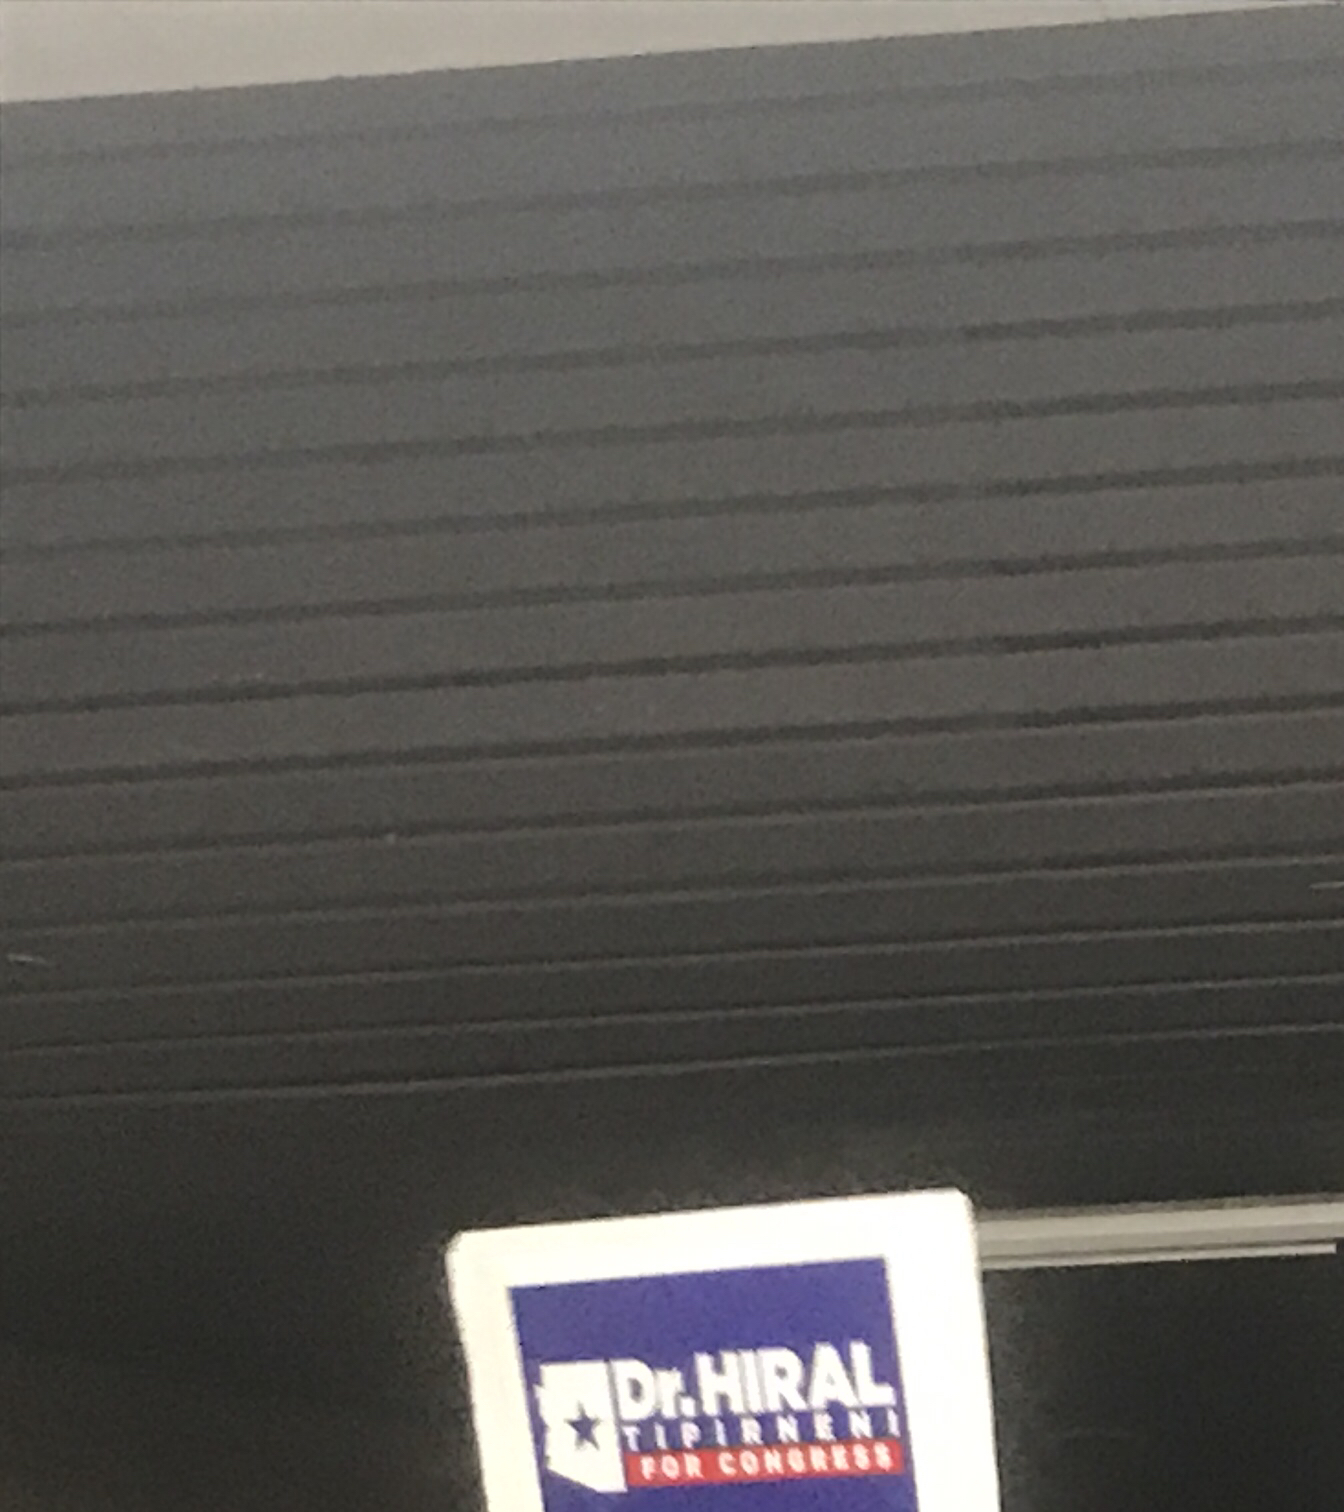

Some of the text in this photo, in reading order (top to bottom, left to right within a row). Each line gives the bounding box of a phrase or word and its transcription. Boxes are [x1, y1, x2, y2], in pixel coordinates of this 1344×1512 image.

[610, 1339, 897, 1421] Dr. HIRAL
[622, 1408, 900, 1451] TIPIRNENI
[640, 1442, 894, 1480] FOR CONGRESS
